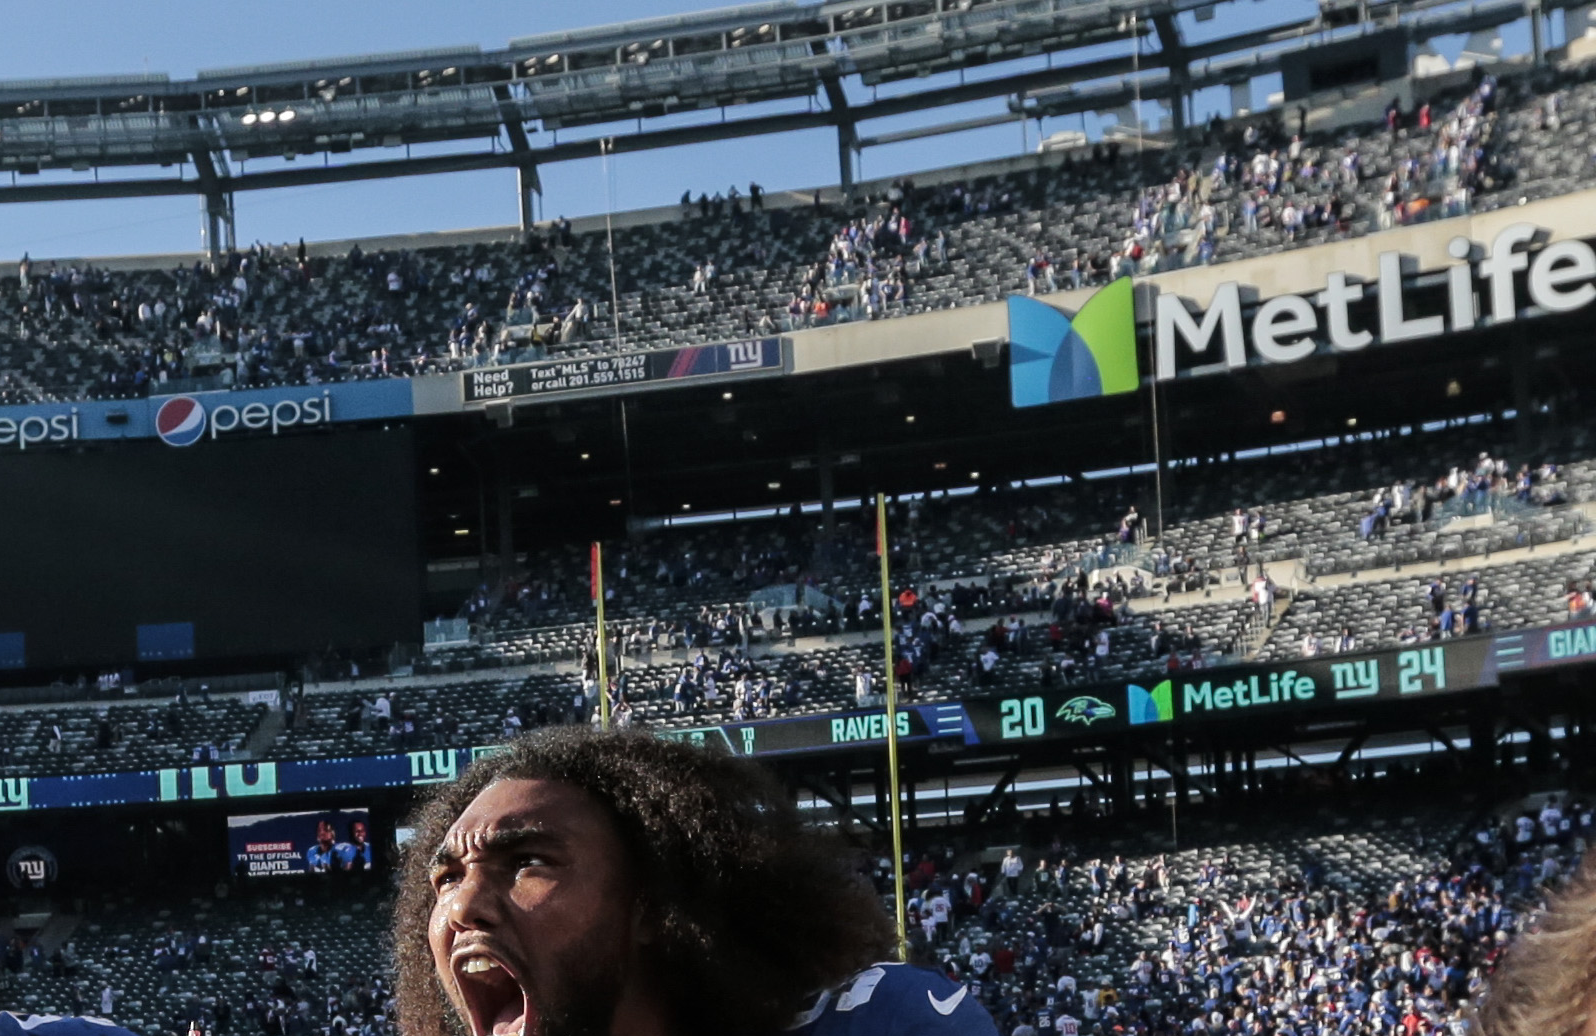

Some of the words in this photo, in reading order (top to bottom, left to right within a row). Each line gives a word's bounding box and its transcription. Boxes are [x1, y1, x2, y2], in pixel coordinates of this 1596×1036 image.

[1156, 222, 1596, 381] MetLife
[473, 369, 510, 384] Need
[530, 367, 556, 380] Text
[597, 359, 609, 371] to
[474, 381, 515, 398] Help?
[531, 380, 544, 391] or
[545, 376, 568, 389] call
[211, 389, 331, 440] pepsi
[1331, 659, 1379, 699] ny
[1398, 647, 1446, 694] 24
[1183, 671, 1315, 713] MetLife
[831, 711, 910, 743] RAVENS
[1000, 696, 1046, 738] 20
[246, 842, 293, 852] SUBSCRIBE
[249, 853, 264, 861] THE
[266, 851, 302, 860] OFFICIAL
[249, 860, 290, 871] GIANTS
